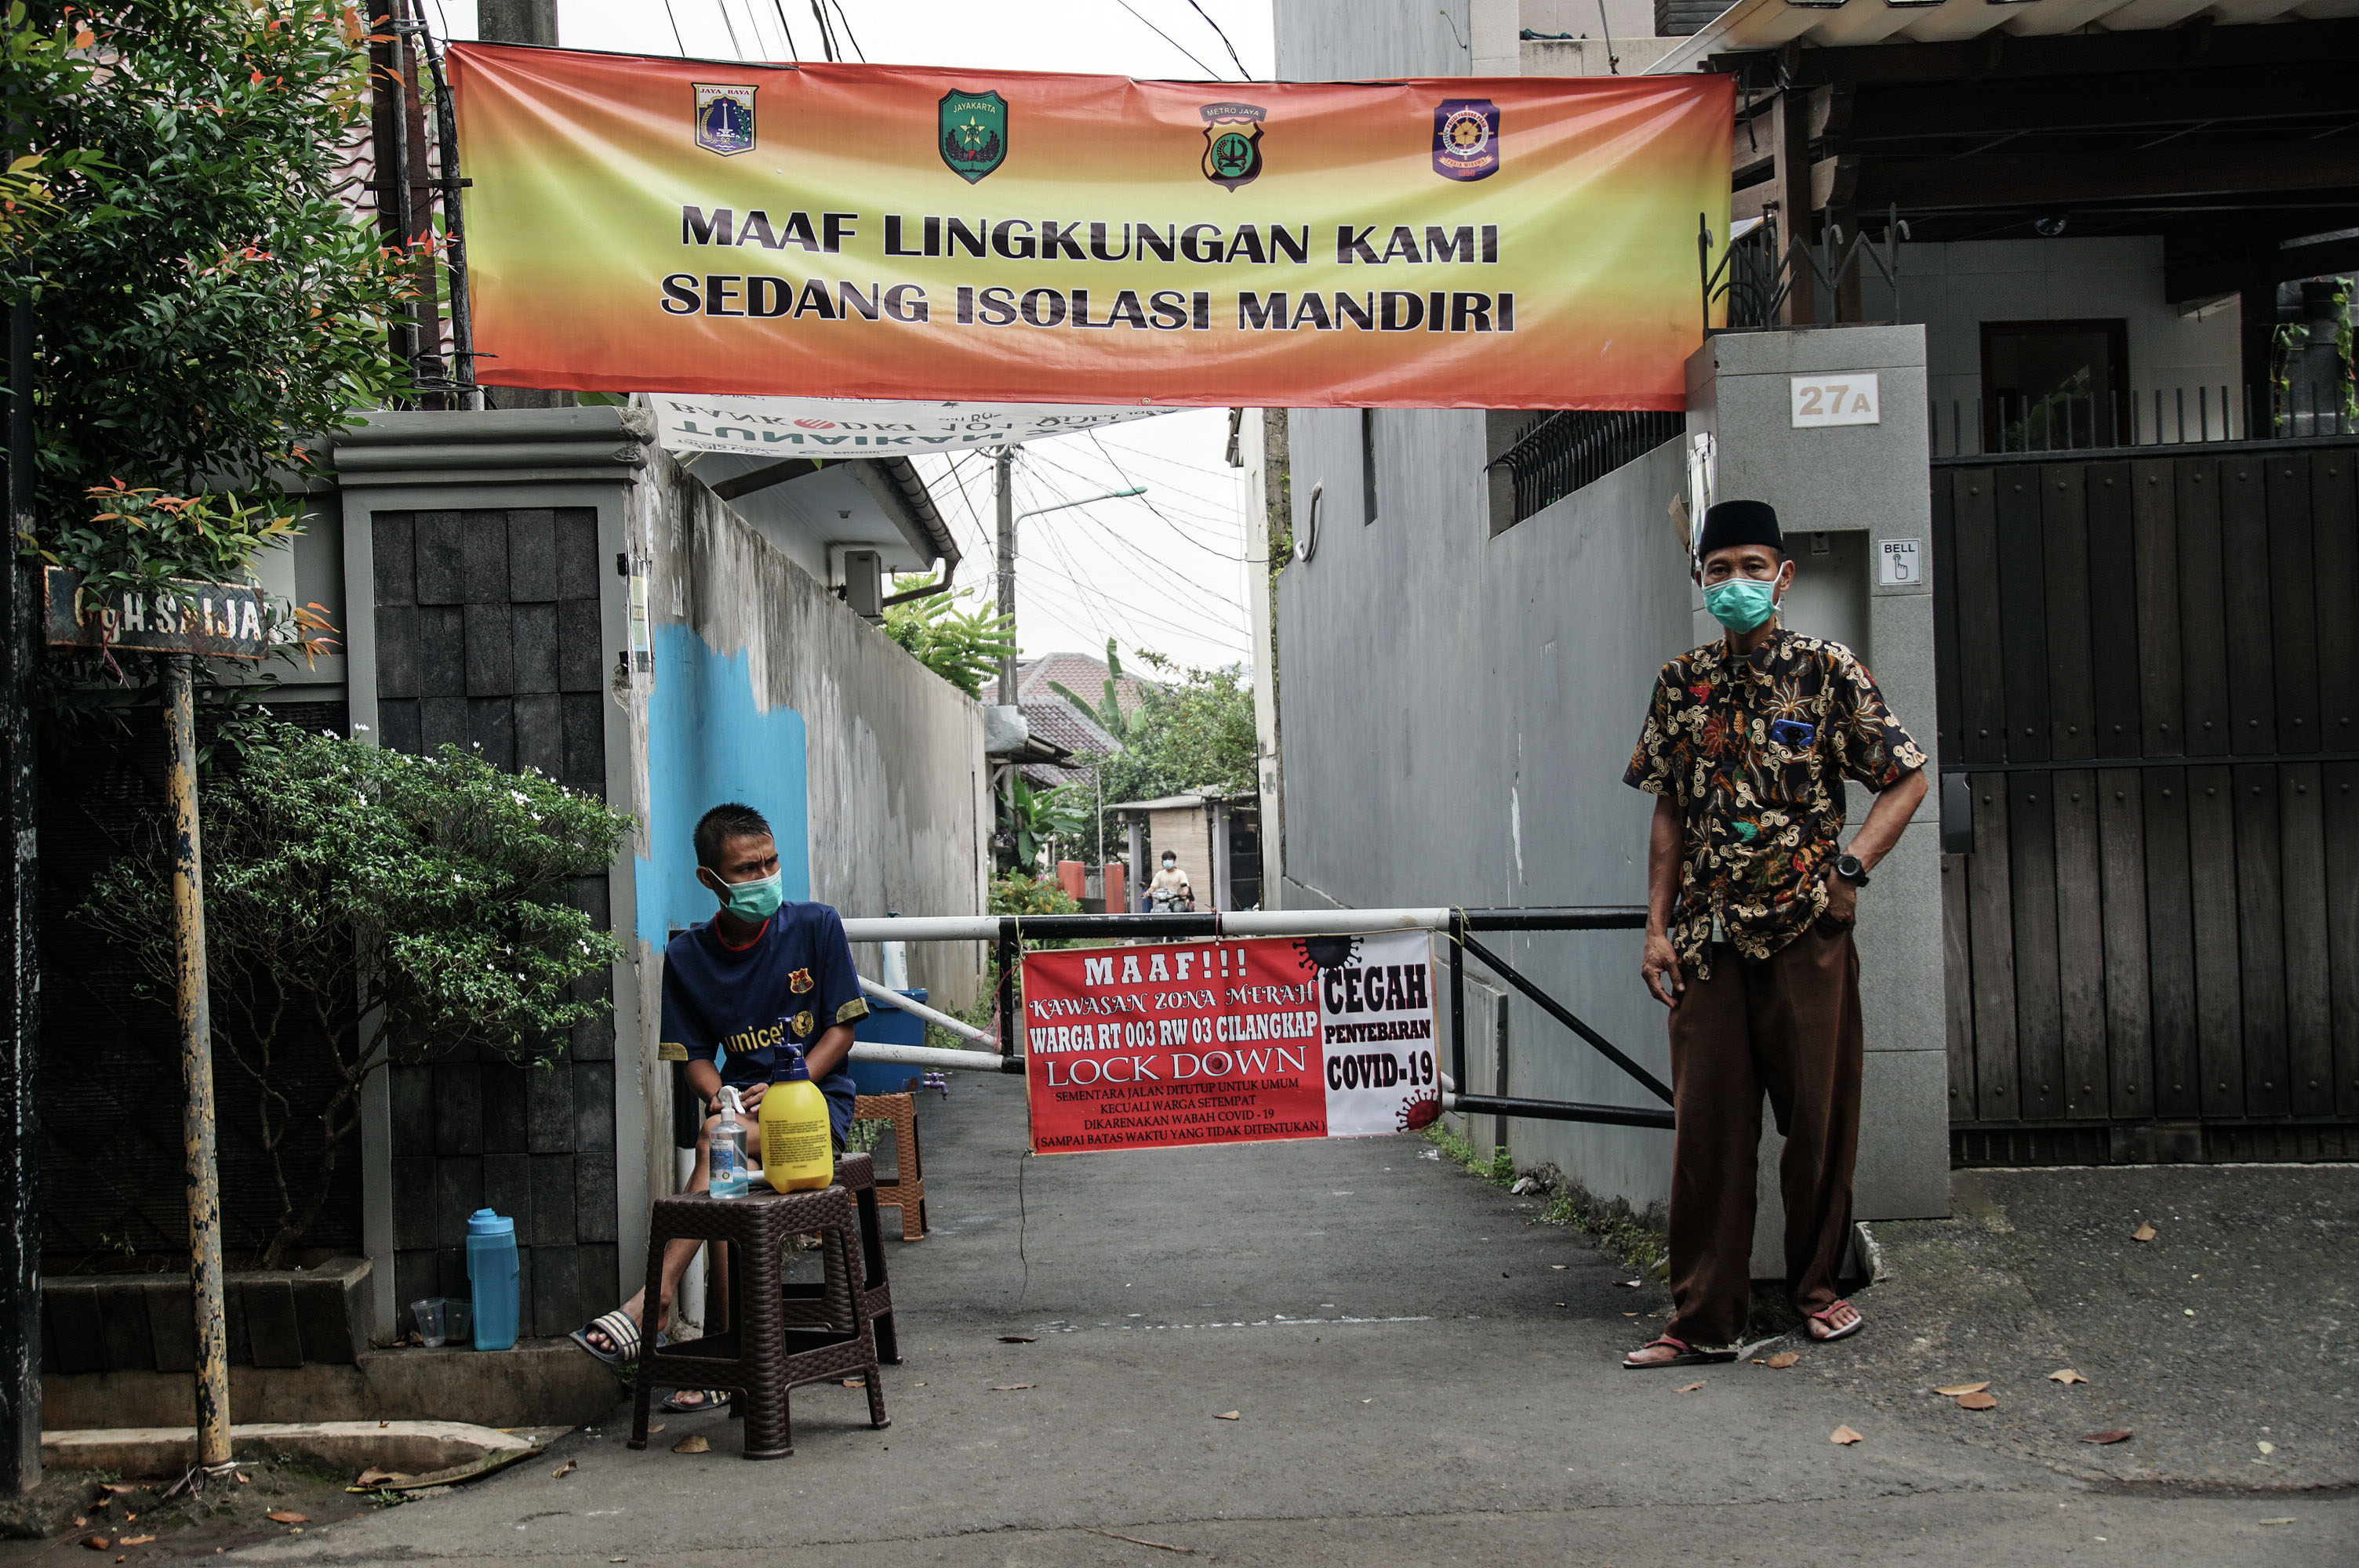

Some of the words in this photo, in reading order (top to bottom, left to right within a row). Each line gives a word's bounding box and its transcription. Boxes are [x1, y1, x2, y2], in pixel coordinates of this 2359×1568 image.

[953, 102, 996, 114] JAYAKARTA
[1206, 107, 1237, 117] METRO
[682, 205, 860, 254] MAAF
[883, 213, 1309, 263] LINGKUNGAN
[1336, 223, 1499, 264] KAMI
[660, 272, 929, 323] SEDANG
[954, 285, 1210, 331] ISOLASI
[1237, 289, 1514, 332] MANDIRI
[1799, 385, 1871, 416] 27A
[1884, 543, 1915, 554] BELL
[1084, 949, 1247, 986] MAAF!!!
[1029, 993, 1148, 1020] KAWASAN
[1154, 989, 1216, 1010] ZONA
[1225, 980, 1316, 1006] MERAH
[1324, 964, 1428, 1014] CEGAH
[1029, 1024, 1097, 1054] WARGA
[1098, 1022, 1121, 1051] RT
[1125, 1020, 1155, 1048] 003
[1159, 1018, 1188, 1046] RW
[1192, 1016, 1212, 1044] 03
[1216, 1011, 1318, 1042] CILANGKAP
[1325, 1019, 1430, 1044] PENYEBARAN
[1044, 1054, 1161, 1087] LOCK
[1169, 1045, 1307, 1080] DOWN
[1327, 1050, 1433, 1091] COVID-19
[1056, 1088, 1125, 1102] SEMENTARA
[1126, 1086, 1164, 1100] JALAN
[1165, 1083, 1216, 1096] DITUTUP
[1217, 1080, 1259, 1093] UNTUK
[1260, 1077, 1299, 1091] UMUM
[1100, 1102, 1150, 1115] KECUALI
[1151, 1098, 1196, 1112] WARGA
[1197, 1094, 1256, 1109] SETEMPAT
[1084, 1116, 1171, 1131] DIKARENAKAN
[1172, 1112, 1216, 1127] WABAH
[1217, 1109, 1255, 1123] COVID
[1263, 1109, 1274, 1120] 19
[1087, 1131, 1124, 1145] BATAS
[1124, 1129, 1169, 1142] WAKTU
[1169, 1126, 1205, 1140] YANG
[1205, 1123, 1242, 1137] TIDAK
[1244, 1120, 1318, 1135] DITENTUKAN
